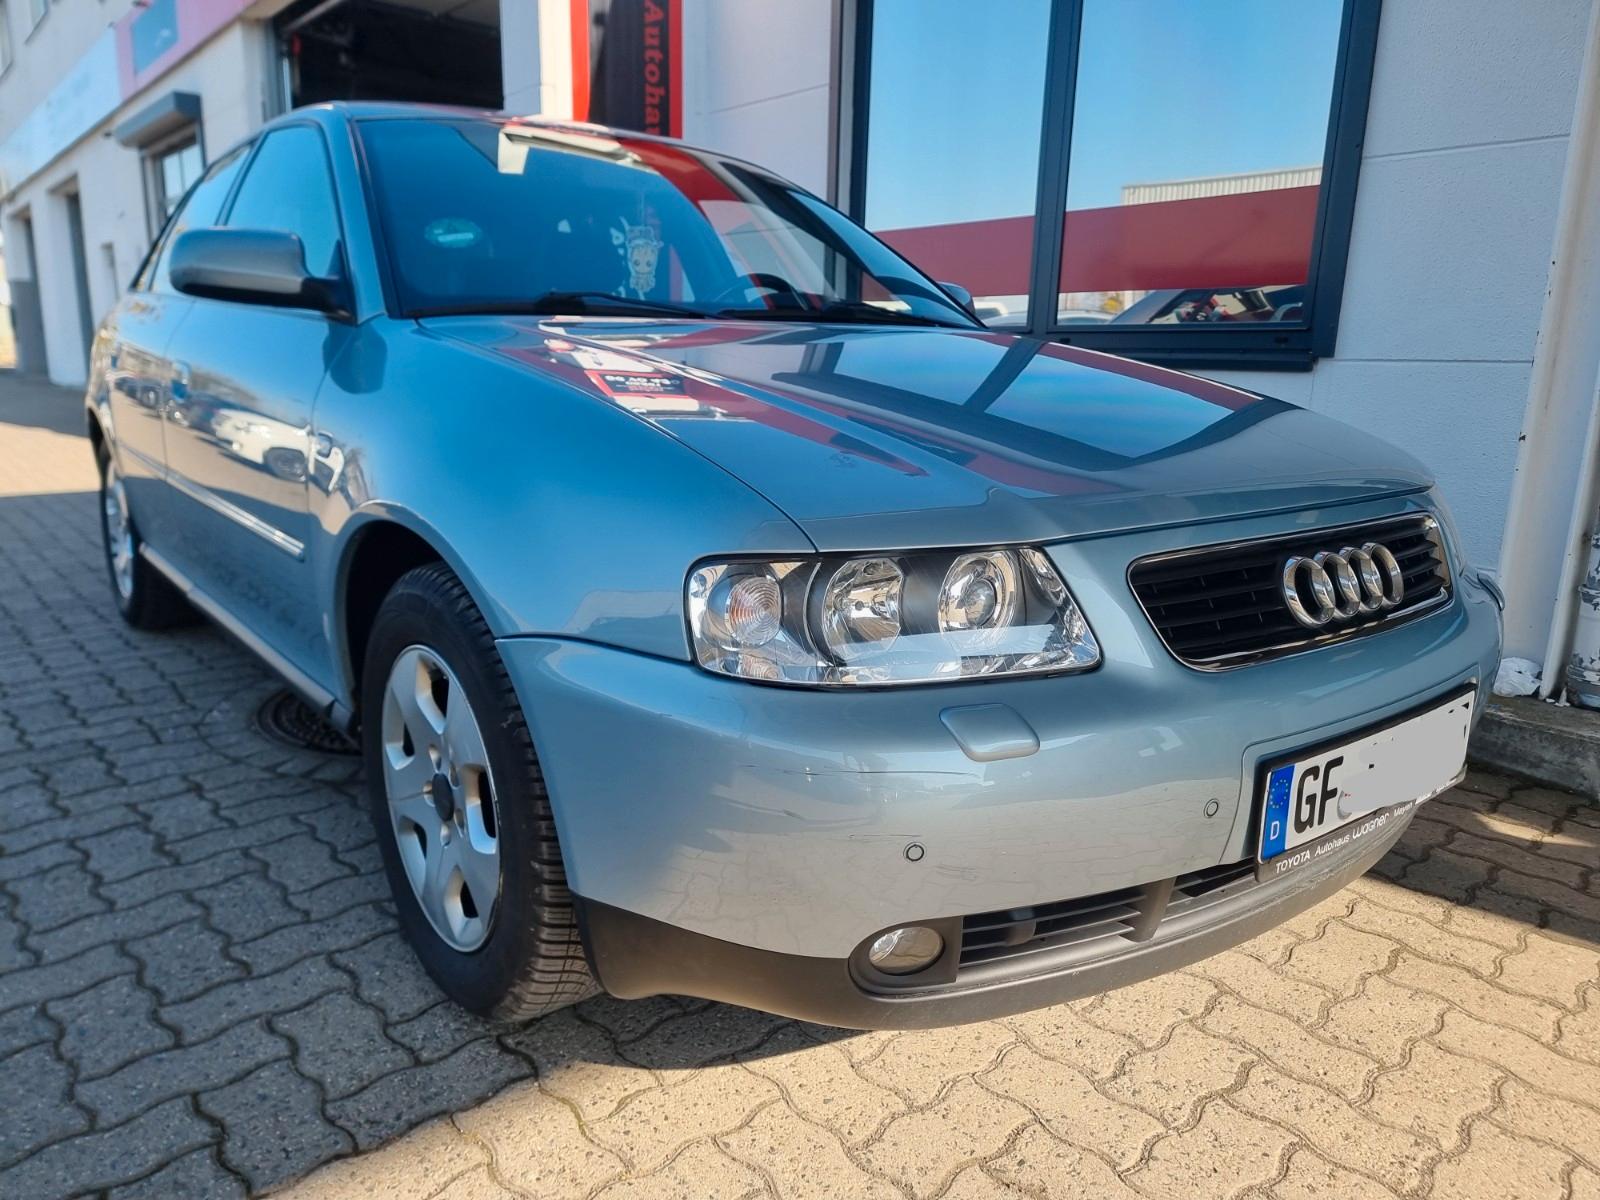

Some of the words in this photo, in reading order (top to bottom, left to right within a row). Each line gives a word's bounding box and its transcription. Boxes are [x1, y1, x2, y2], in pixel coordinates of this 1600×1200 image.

[1293, 755, 1344, 834] GF
[1270, 820, 1280, 841] D
[1275, 849, 1311, 874] TOYOTA
[1314, 833, 1351, 857] Autohaus
